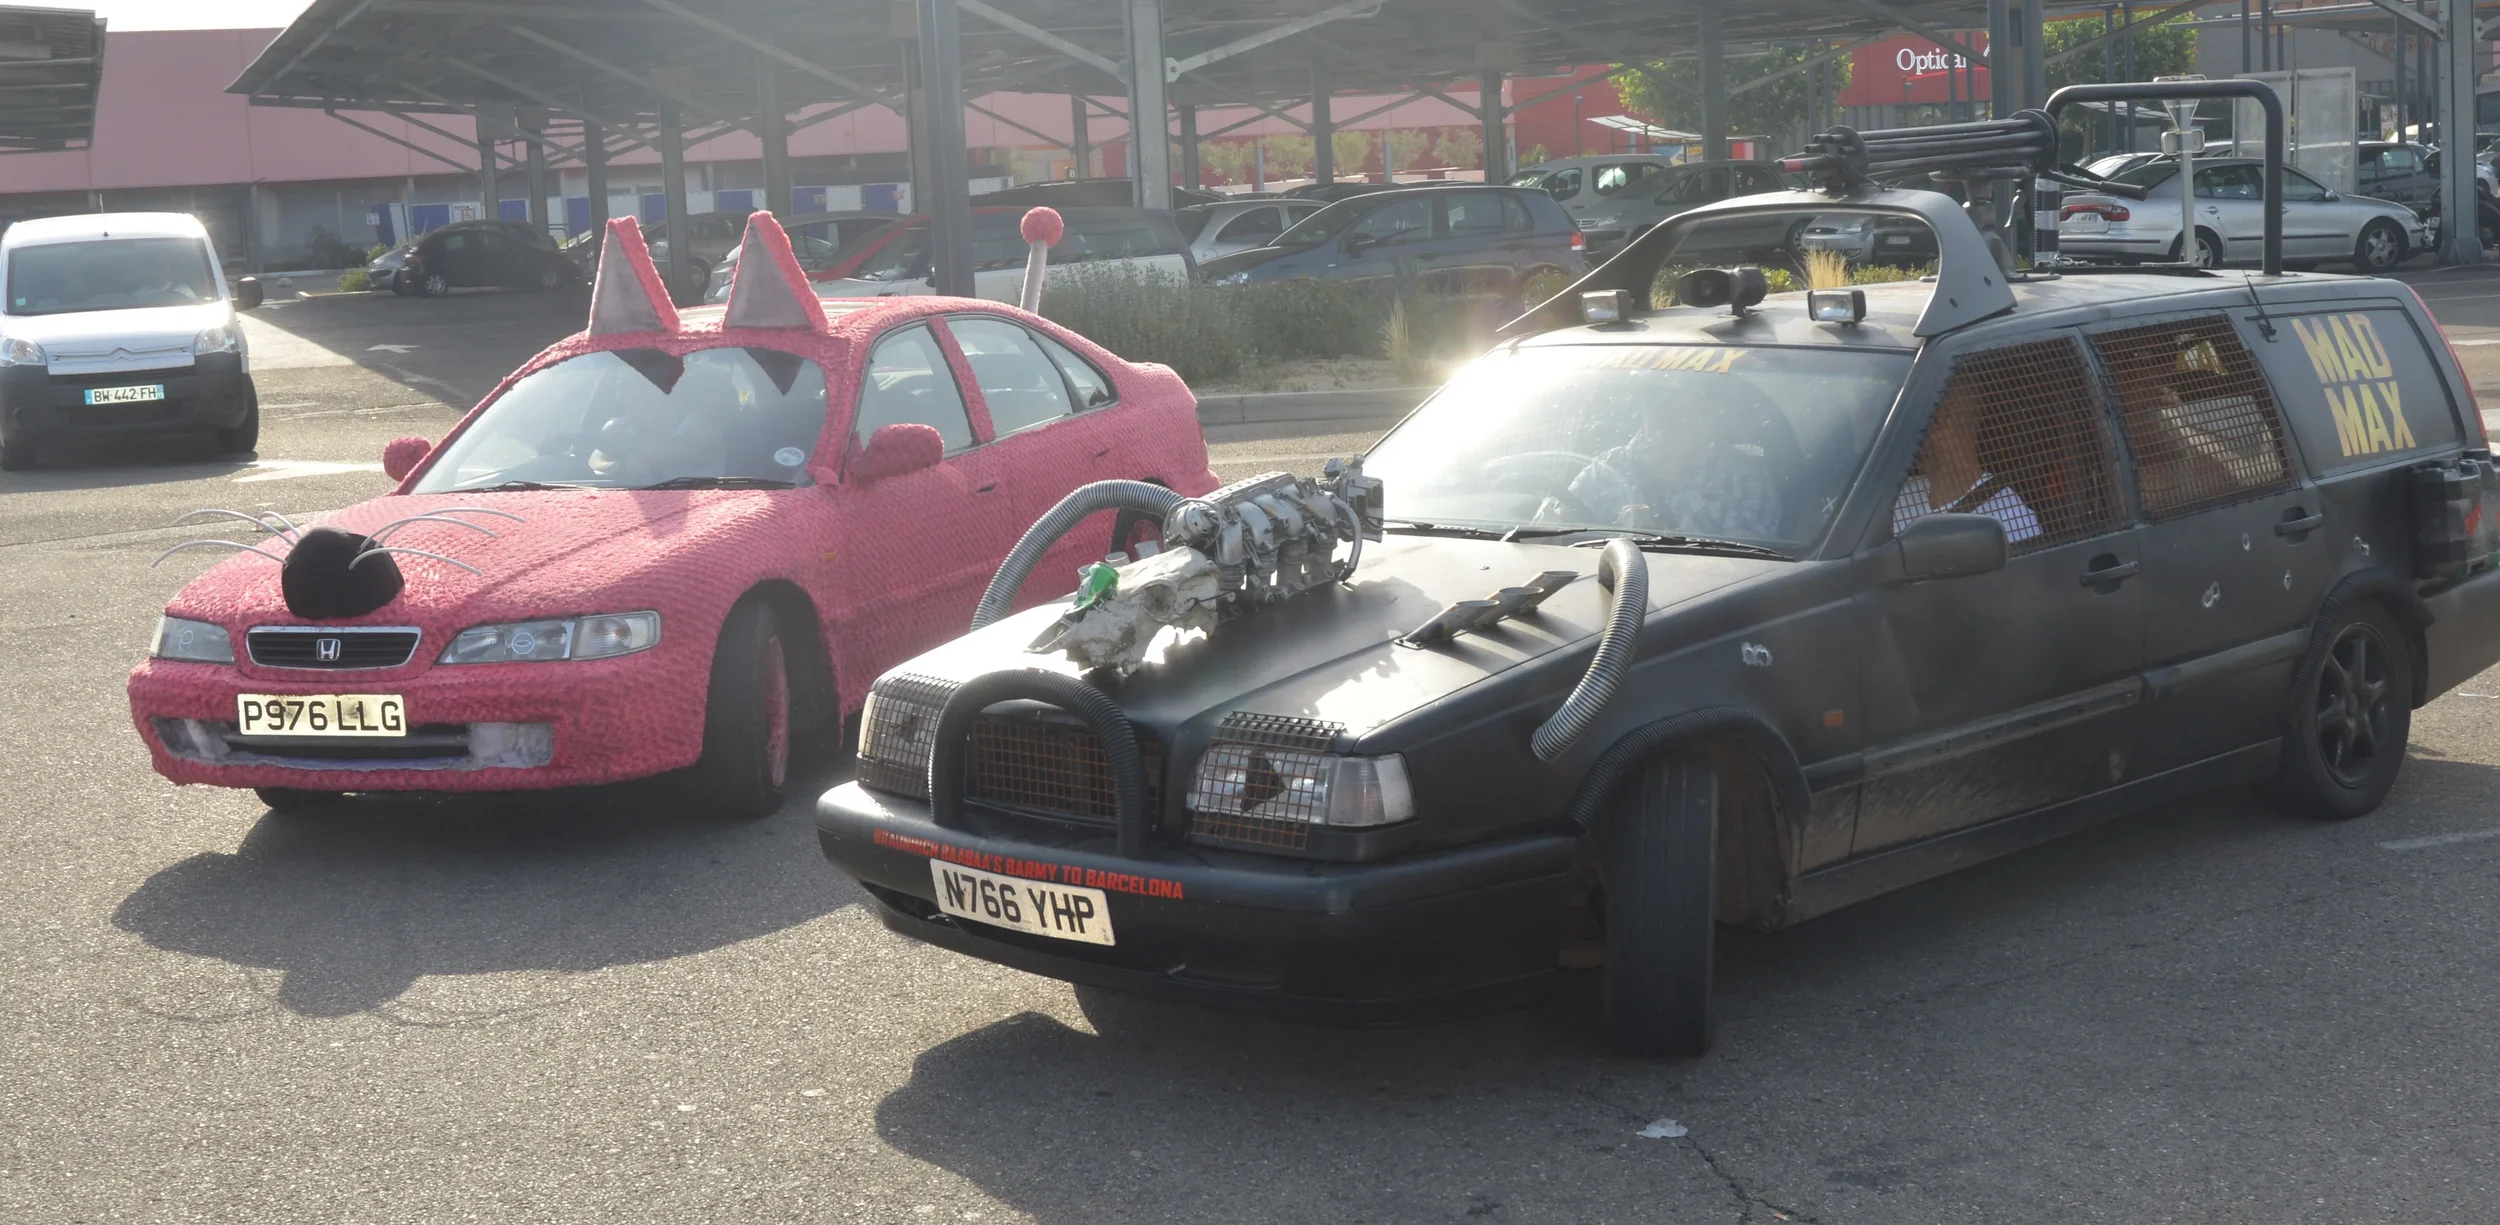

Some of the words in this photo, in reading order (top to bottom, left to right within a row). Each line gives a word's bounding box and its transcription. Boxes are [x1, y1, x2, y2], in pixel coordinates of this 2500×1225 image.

[1578, 348, 1655, 370] AD
[1650, 347, 1749, 374] MAX
[2290, 313, 2393, 384] MAD
[2323, 380, 2417, 457] MAX
[244, 700, 328, 731] P976
[336, 700, 401, 731] LLG
[942, 869, 1021, 922] N766
[1026, 887, 1095, 934] YHP
[1005, 858, 1057, 883] BARMY
[1062, 865, 1083, 885] TO
[1085, 868, 1184, 900] BARCELONA
